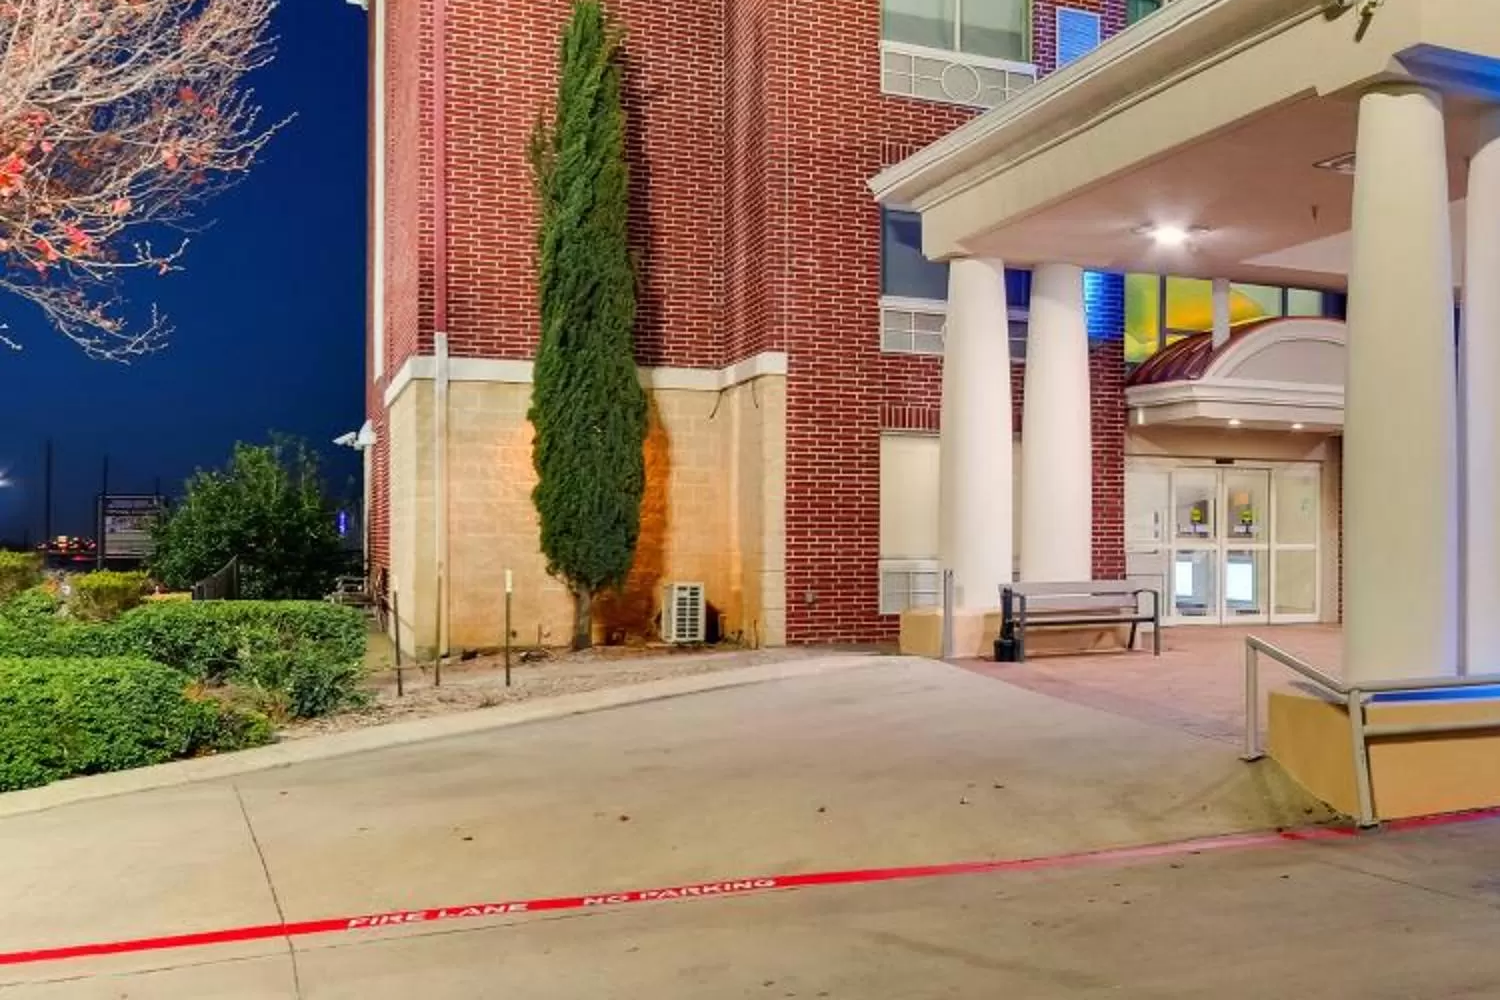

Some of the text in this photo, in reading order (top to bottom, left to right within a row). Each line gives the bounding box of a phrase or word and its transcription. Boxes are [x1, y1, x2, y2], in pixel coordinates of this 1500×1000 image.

[348, 878, 776, 929] FIRE LANE NO PARKING
